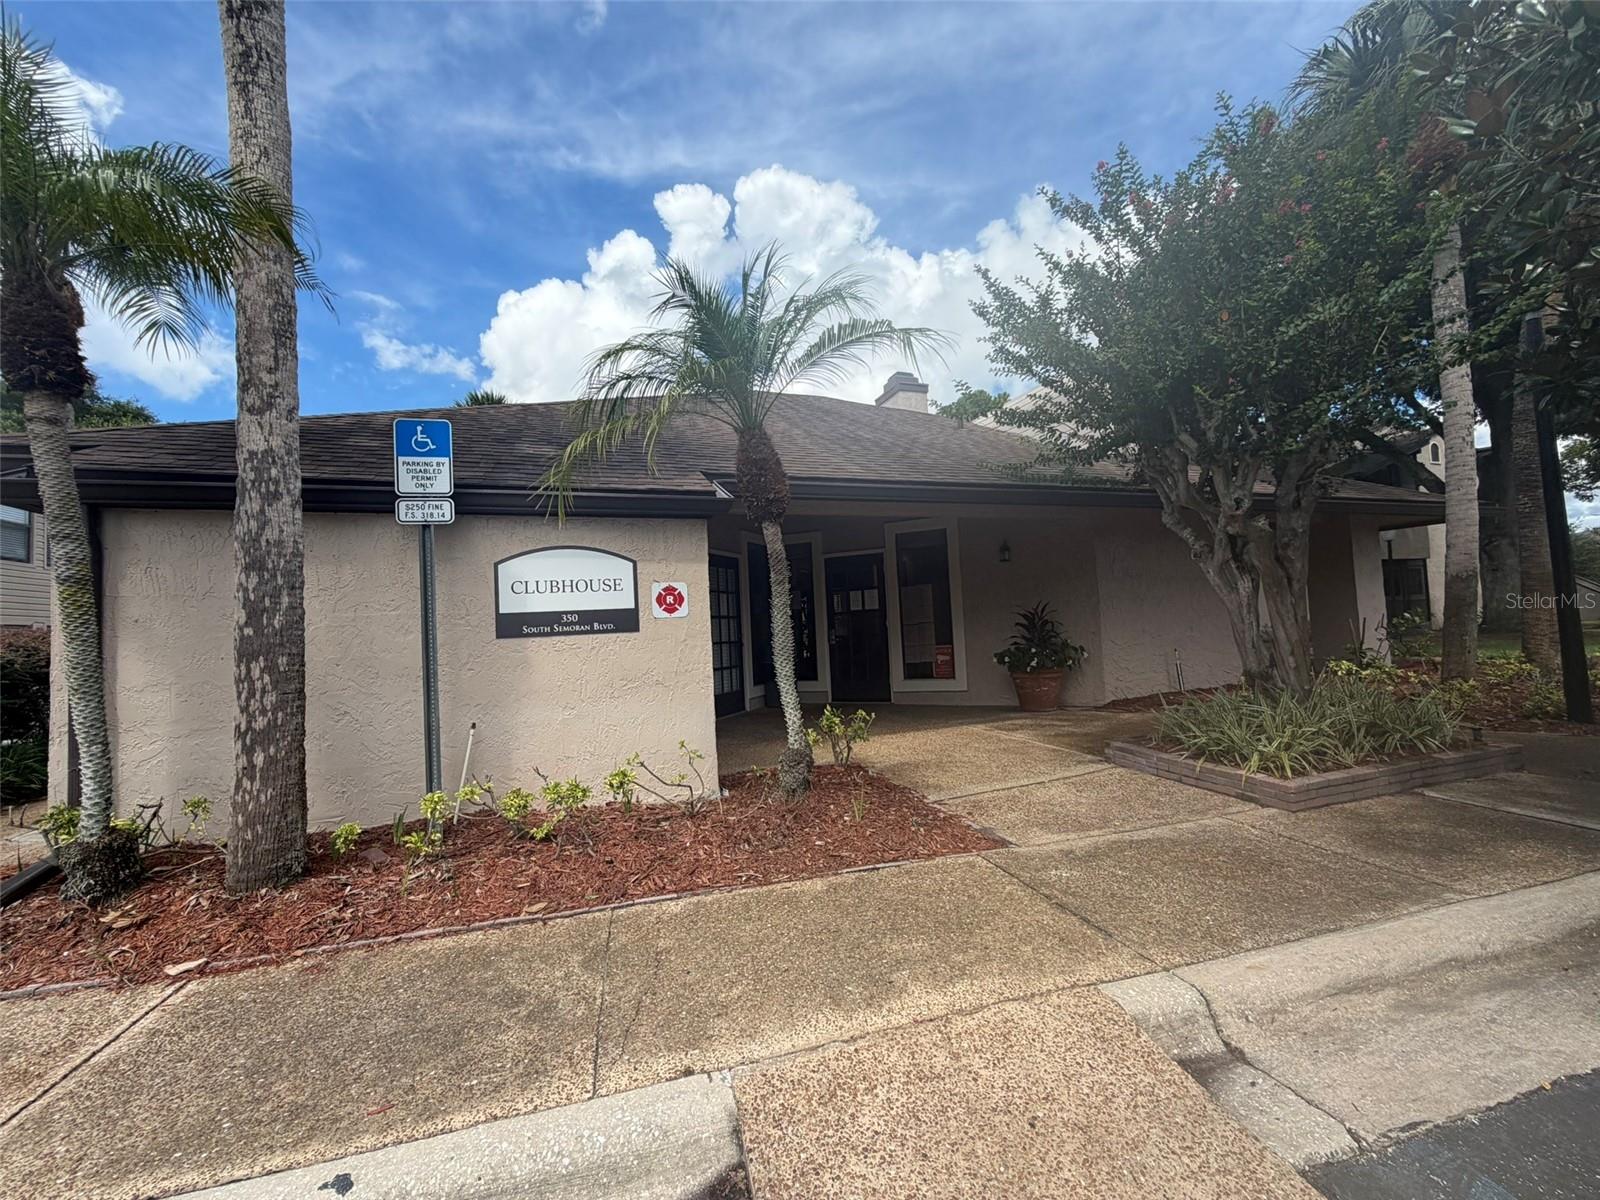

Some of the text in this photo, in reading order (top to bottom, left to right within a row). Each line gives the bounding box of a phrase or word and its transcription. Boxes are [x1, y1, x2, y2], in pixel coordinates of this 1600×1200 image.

[404, 503, 444, 511] $250 FINE
[510, 577, 624, 595] CLUBHOUSE
[666, 595, 675, 604] R
[560, 613, 579, 623] 350
[522, 622, 616, 634] SOUTH SEMORAN BLVD.
